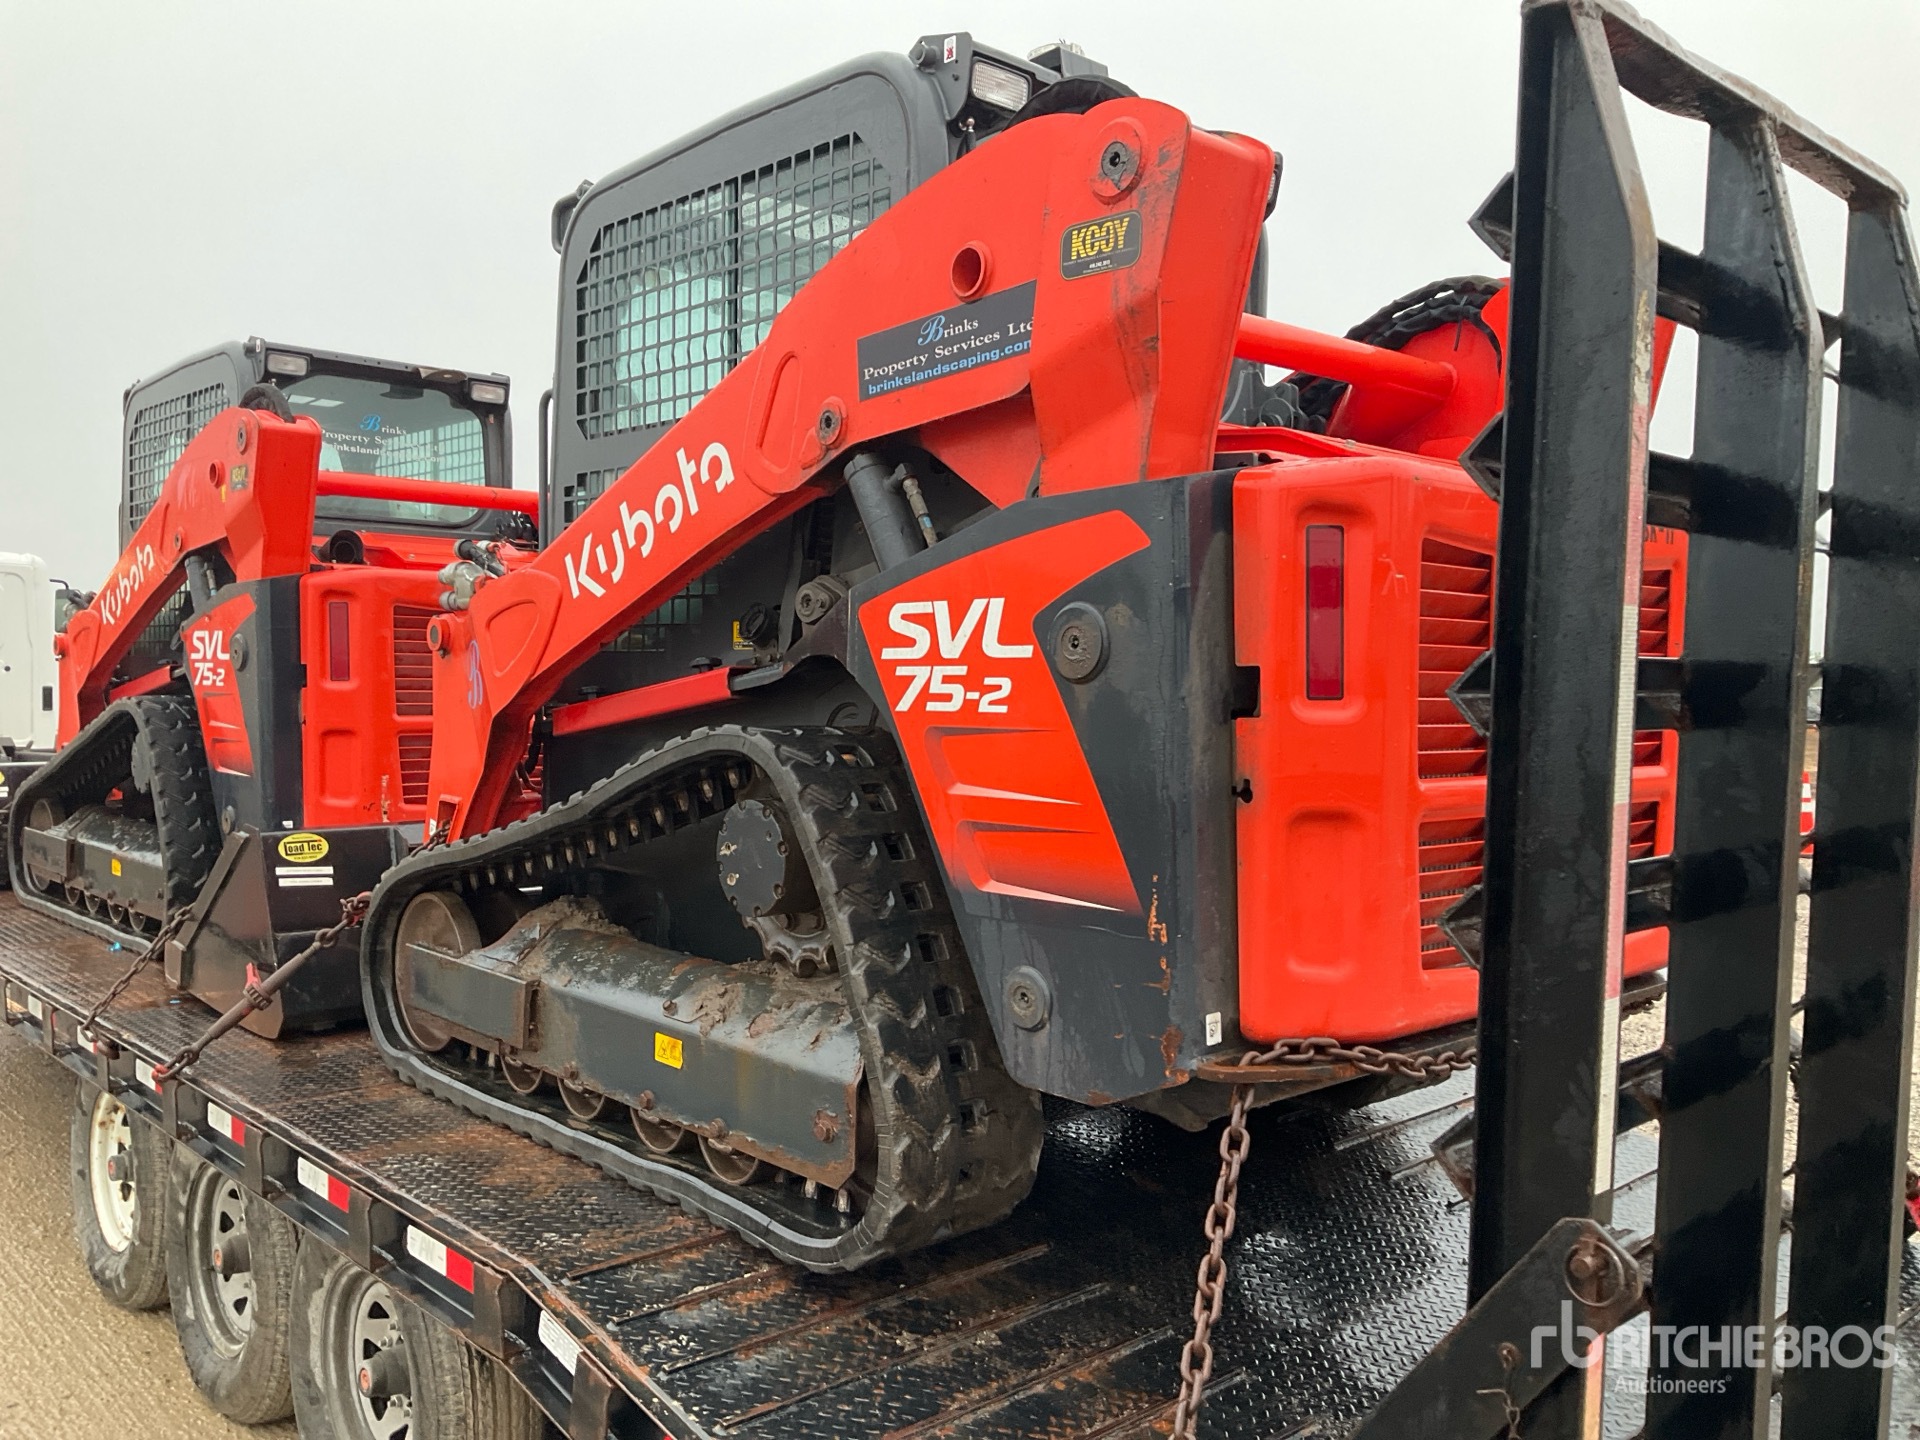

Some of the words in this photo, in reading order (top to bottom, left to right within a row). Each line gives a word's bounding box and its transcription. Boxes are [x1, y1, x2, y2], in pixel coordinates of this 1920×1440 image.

[917, 314, 979, 346] Brinks
[863, 353, 929, 380] Property
[934, 331, 1000, 359] Services
[564, 442, 735, 599] Kubota
[100, 544, 155, 625] Kubota
[190, 630, 231, 660] SVL
[881, 597, 1034, 660] SVL
[194, 663, 226, 687] 75-2
[894, 665, 1012, 713] 75-2
